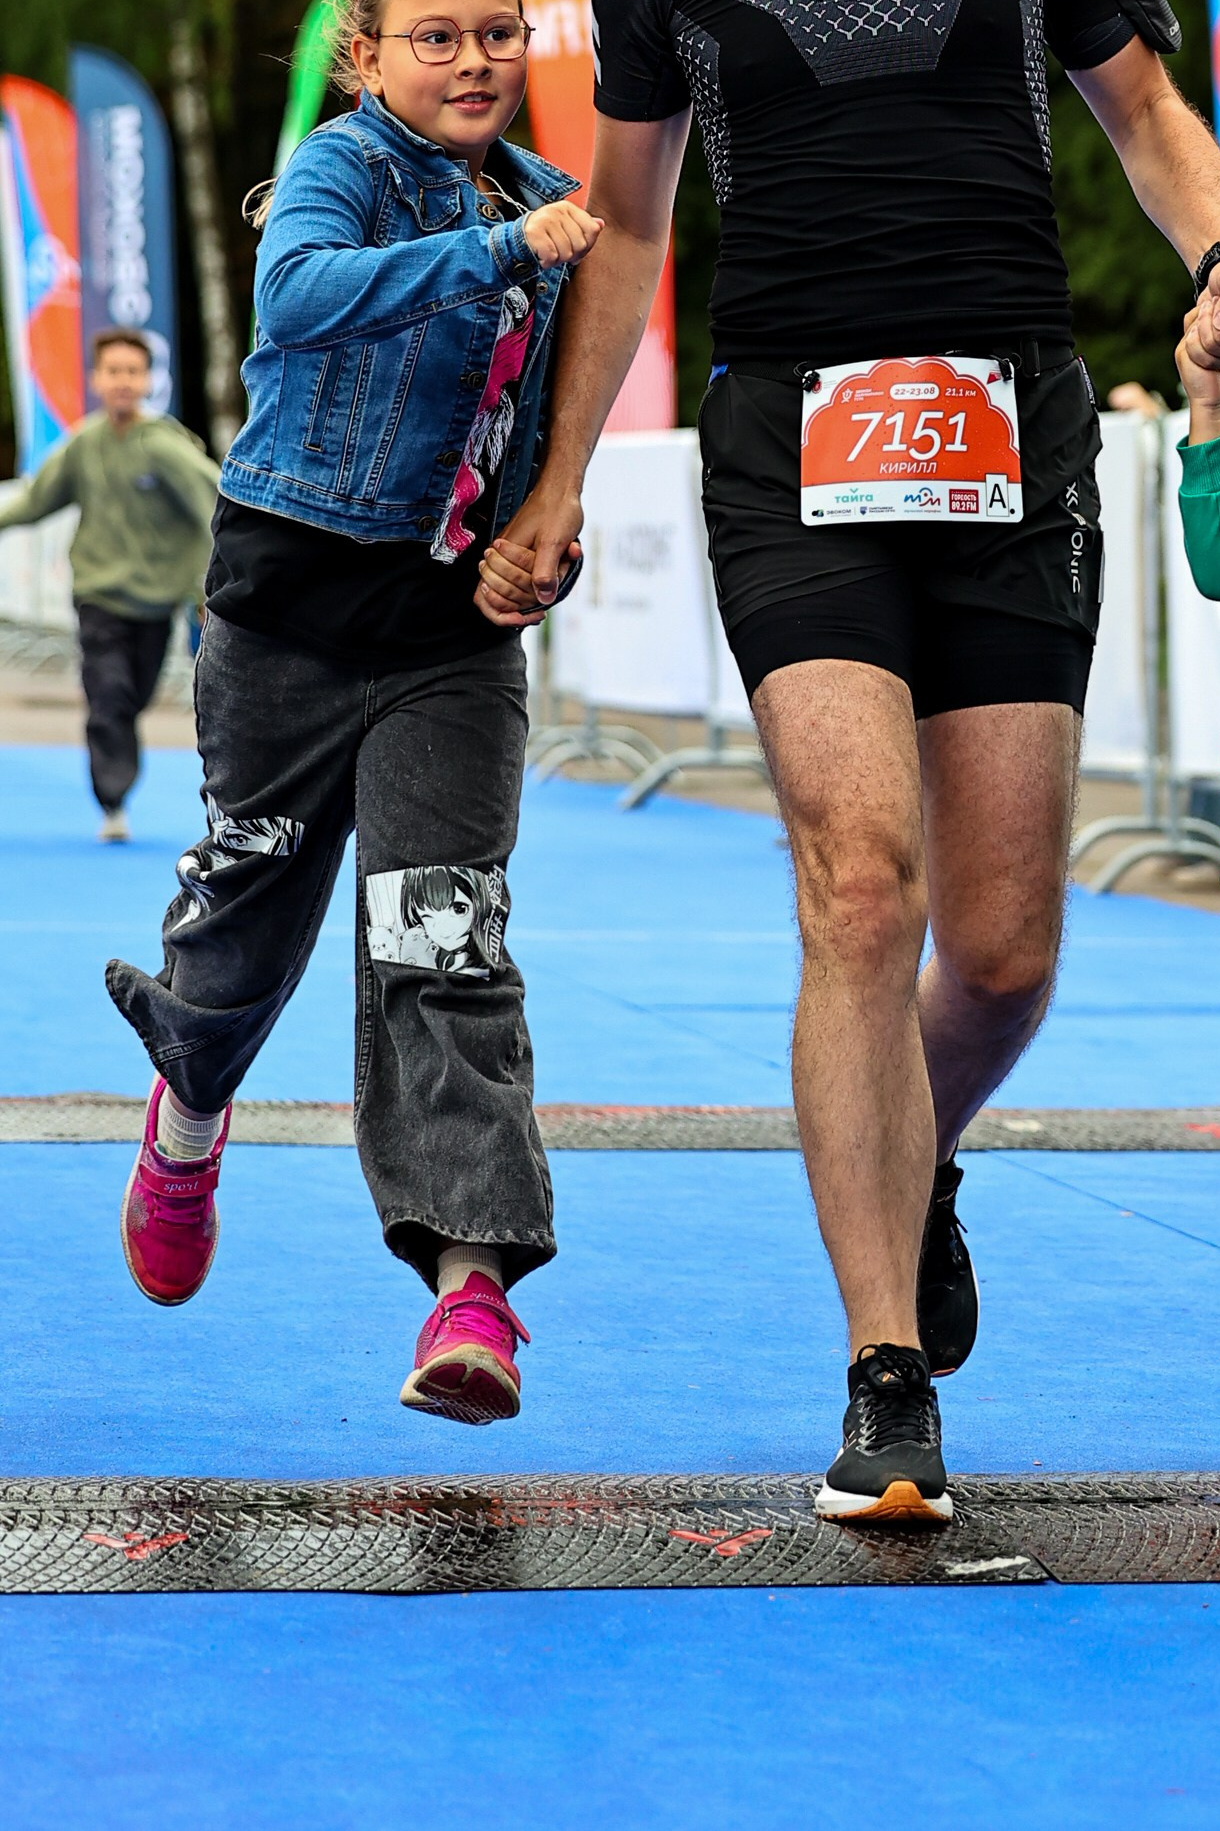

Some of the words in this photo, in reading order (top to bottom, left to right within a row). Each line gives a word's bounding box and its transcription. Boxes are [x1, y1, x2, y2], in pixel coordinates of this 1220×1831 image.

[894, 386, 935, 397] 22-23.08
[847, 411, 967, 462] 7151
[879, 461, 937, 474] КИРИЛЛ
[834, 487, 874, 503] тайга
[988, 483, 1007, 509] A
[951, 502, 966, 511] 89.2
[966, 502, 977, 511] FM
[164, 1181, 198, 1194] sport
